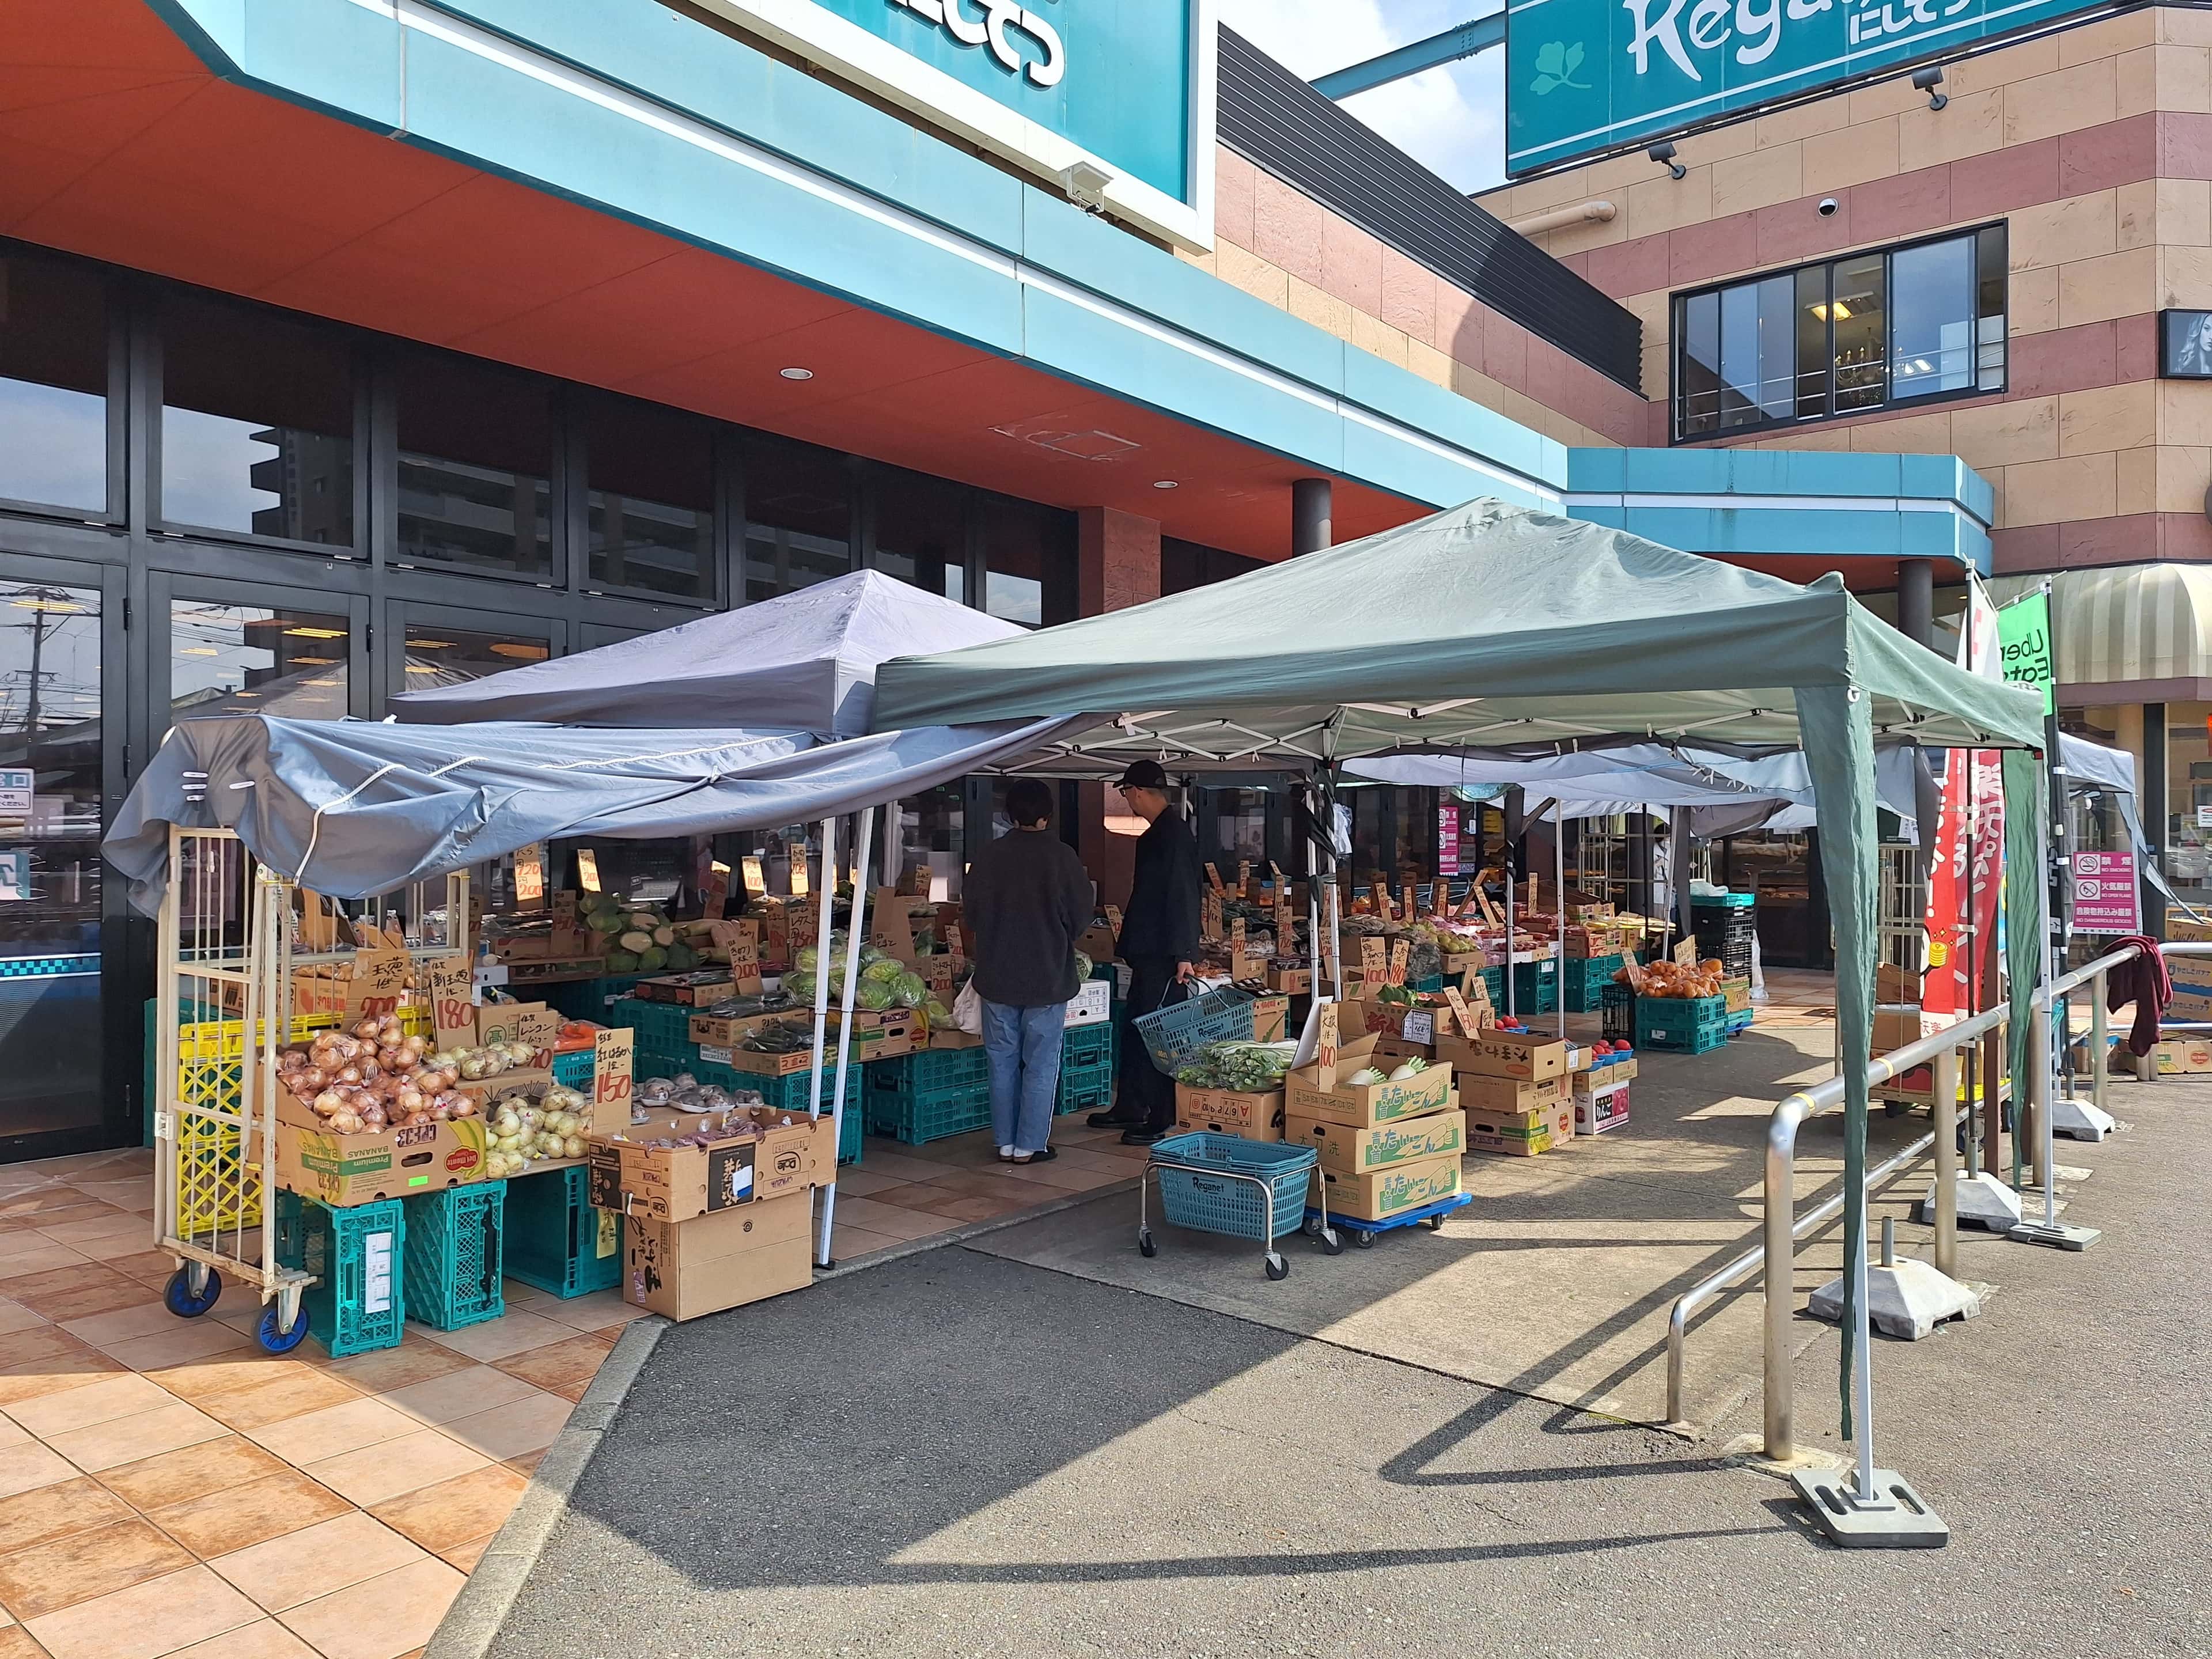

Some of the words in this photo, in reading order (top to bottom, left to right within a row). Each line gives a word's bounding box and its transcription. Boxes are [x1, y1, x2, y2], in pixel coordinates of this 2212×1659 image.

[748, 875, 761, 888] 100
[734, 963, 759, 980] 200
[1365, 968, 1387, 985] 100
[1390, 963, 1405, 984] 180
[933, 978, 950, 991] 200
[437, 998, 475, 1031] 180
[1321, 1014, 1338, 1029] 大根
[521, 1024, 554, 1036] レンコン
[1198, 1023, 1224, 1038] Reganet
[1320, 1042, 1336, 1069] 100
[1469, 1039, 1529, 1062] たまねぎ
[597, 1071, 631, 1104] 150
[1202, 1103, 1209, 1112] 10
[1380, 1086, 1391, 1119] 青首
[1390, 1084, 1430, 1110] だいこん
[1225, 1107, 1230, 1116] 7
[1232, 1107, 1237, 1116] 6
[1240, 1105, 1249, 1117] A
[1596, 1103, 1612, 1120] りんご
[302, 1142, 338, 1158] BANANAS
[348, 1145, 389, 1158] BANANAS
[1298, 1133, 1340, 1157] 大刀洗
[1370, 1130, 1382, 1164] 青首
[1382, 1129, 1436, 1154] だいこん
[354, 1156, 389, 1167] Premium
[446, 1157, 467, 1167] Monte
[467, 1155, 477, 1163] Del
[778, 1158, 797, 1171] Dole
[1192, 1176, 1225, 1193] Reganet
[1382, 1176, 1394, 1210] 青首
[1393, 1173, 1437, 1198] だいこん
